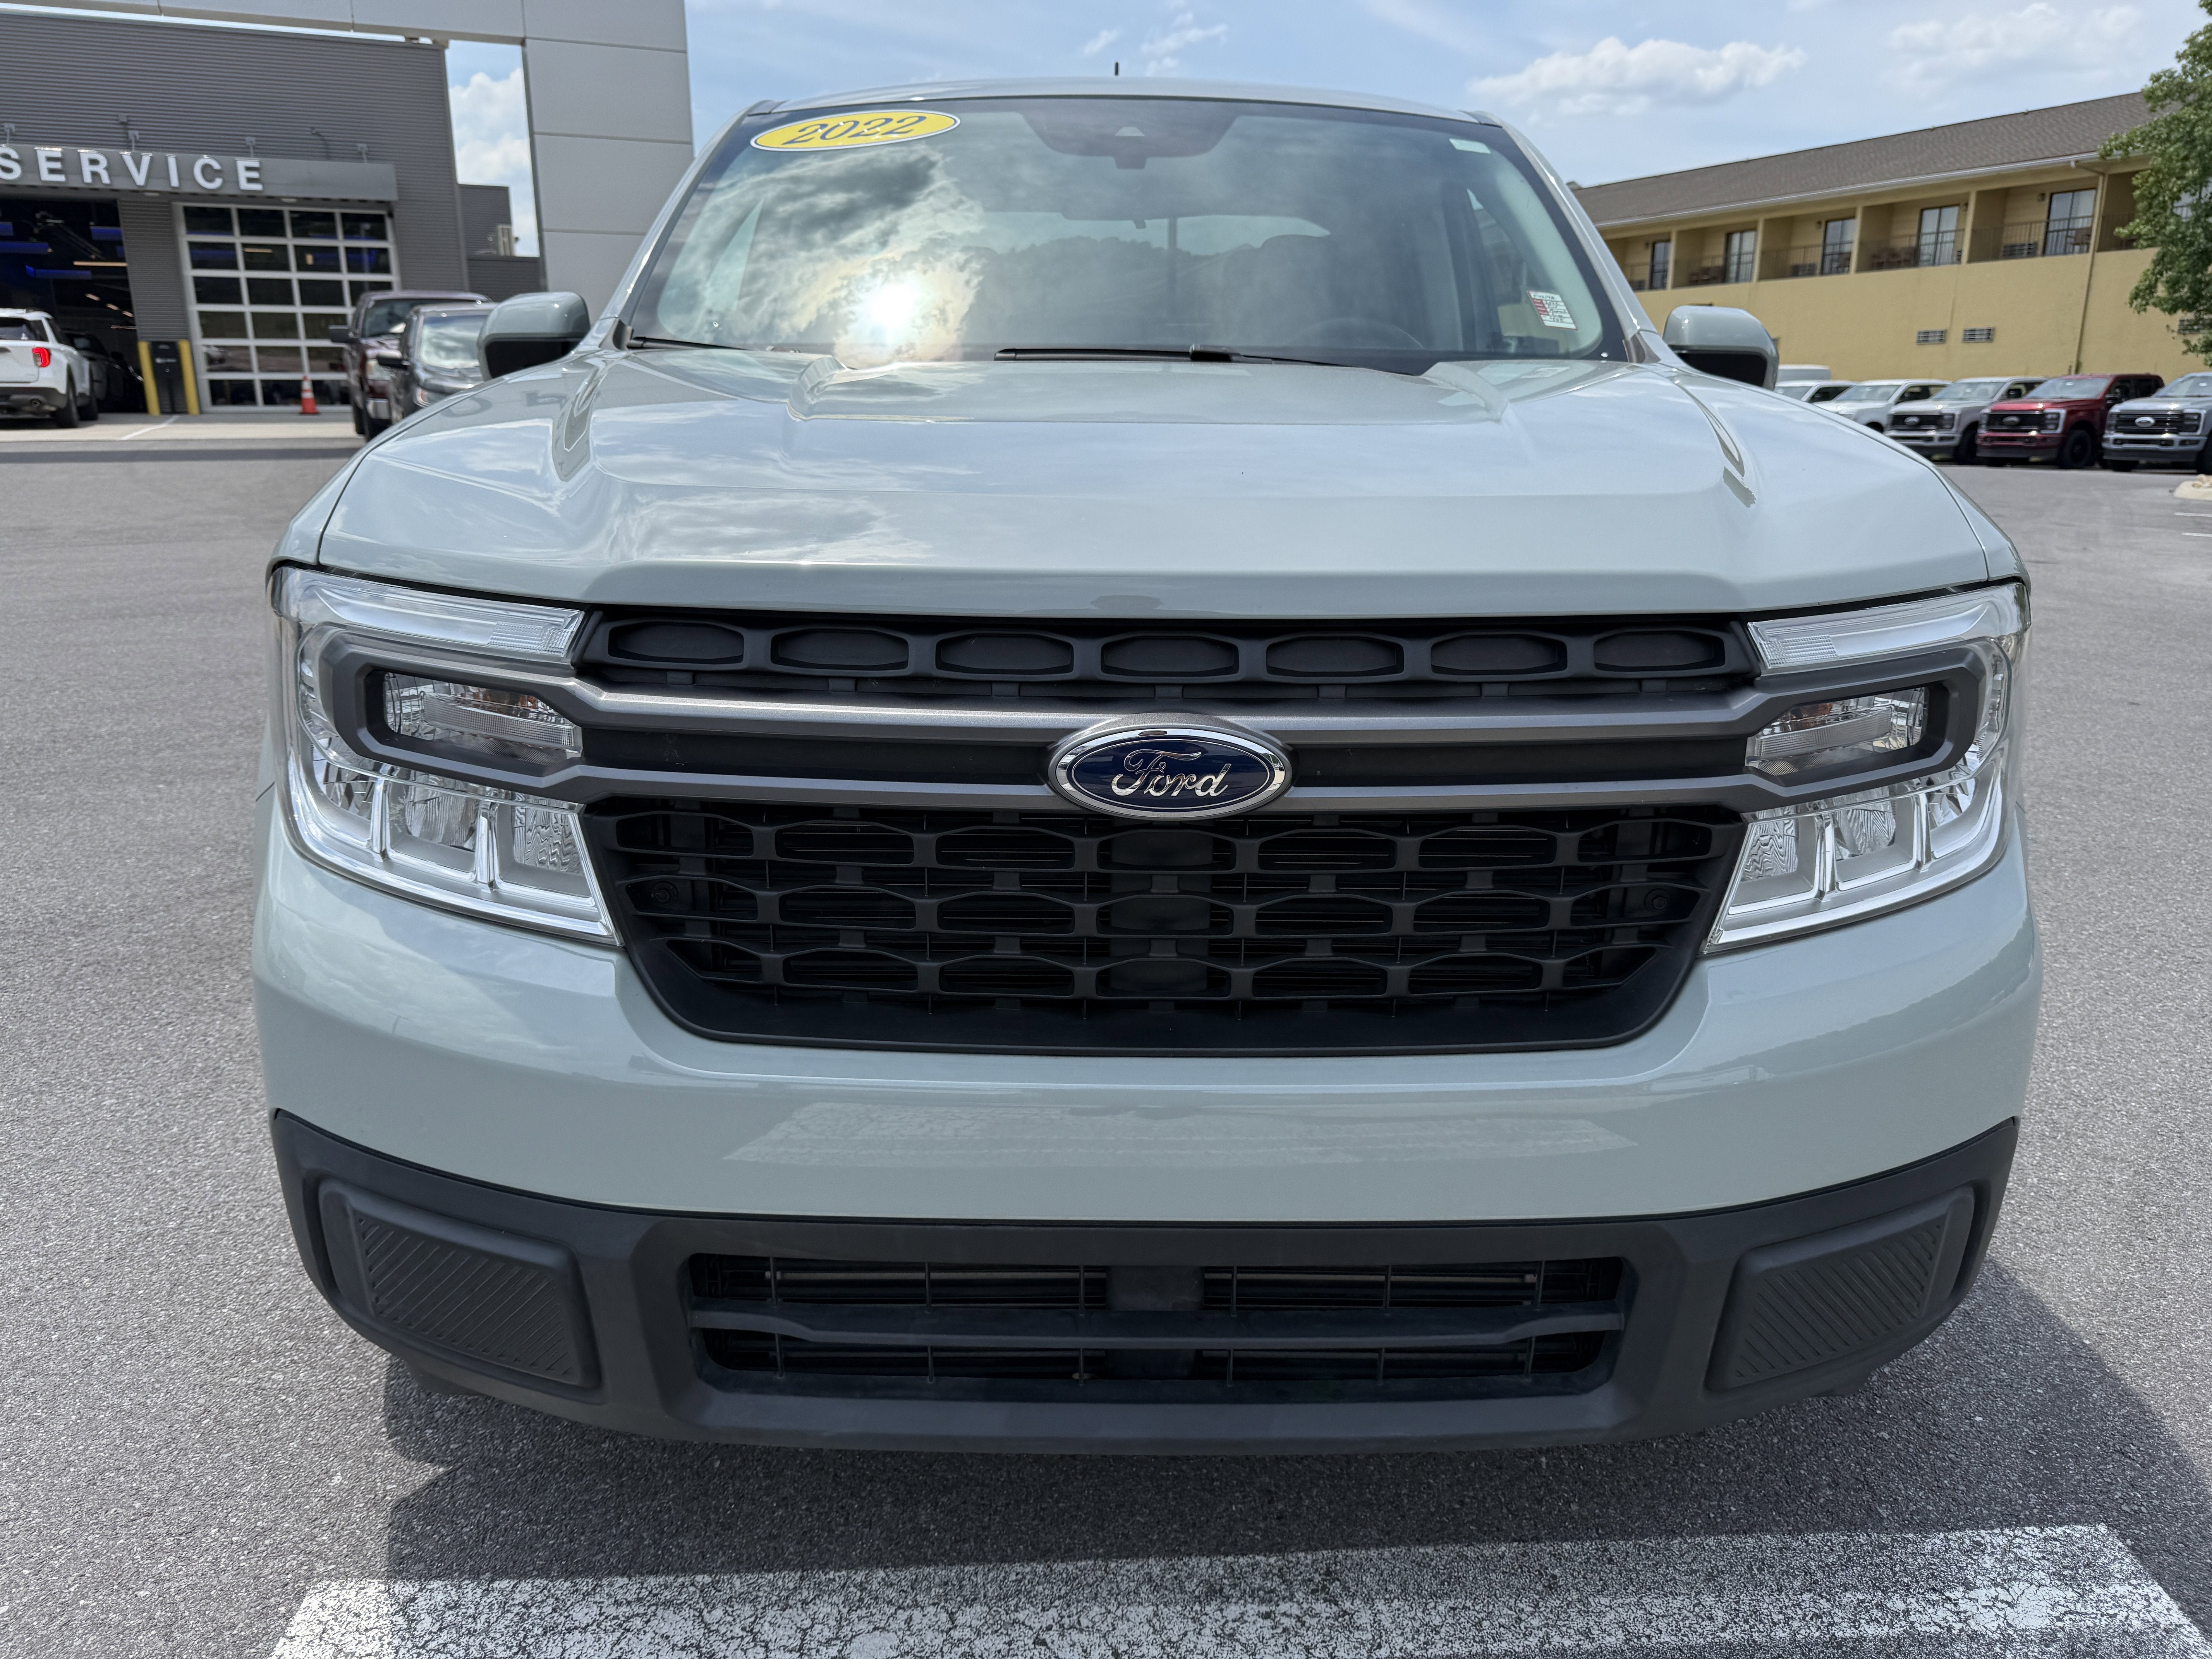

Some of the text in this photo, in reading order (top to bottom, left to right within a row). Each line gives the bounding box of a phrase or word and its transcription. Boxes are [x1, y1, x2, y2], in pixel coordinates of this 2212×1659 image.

[781, 116, 927, 145] 2022
[0, 144, 263, 191] SERVICE
[1111, 749, 1231, 797] Ford
